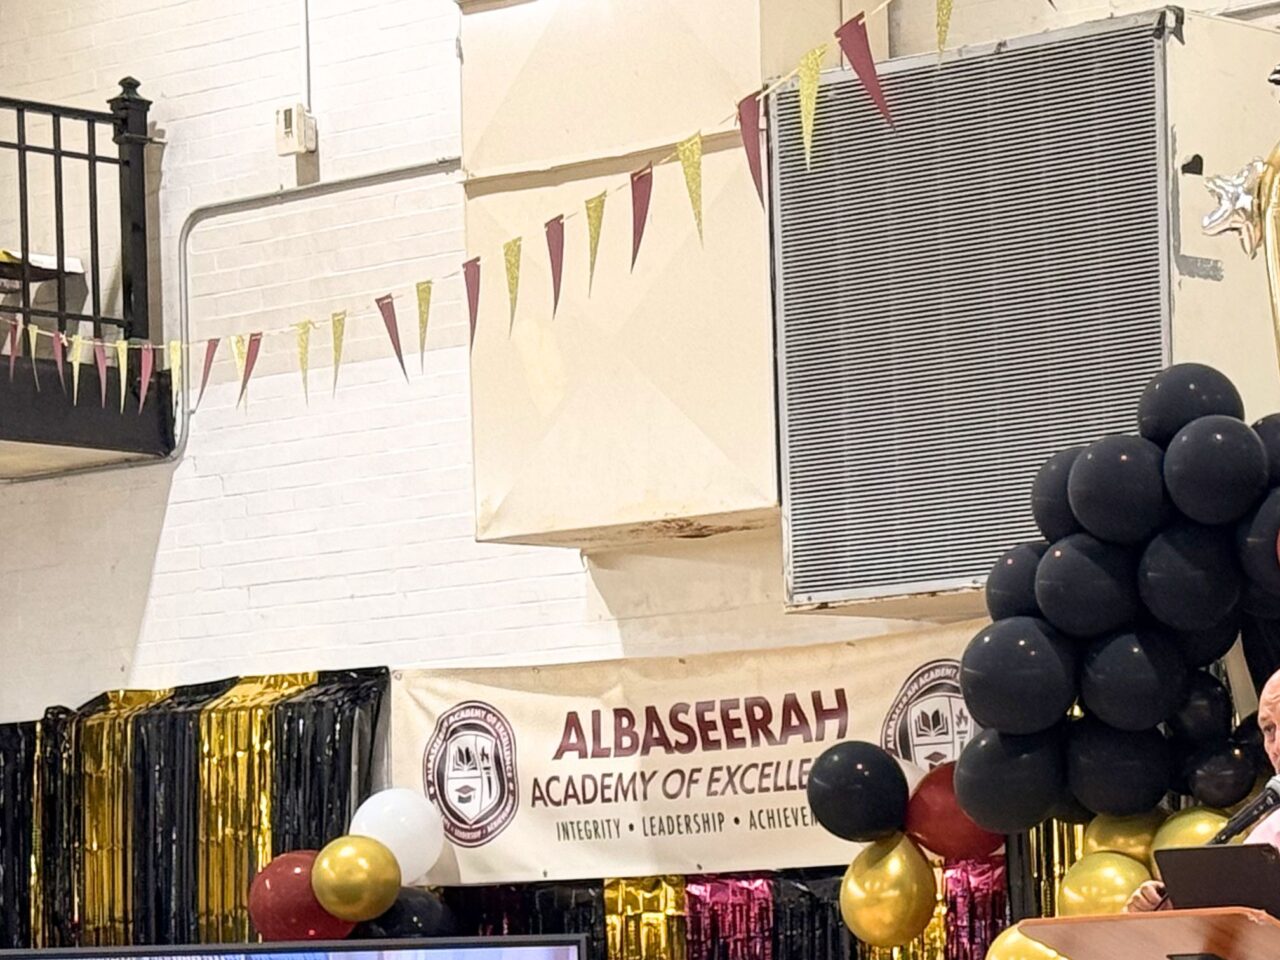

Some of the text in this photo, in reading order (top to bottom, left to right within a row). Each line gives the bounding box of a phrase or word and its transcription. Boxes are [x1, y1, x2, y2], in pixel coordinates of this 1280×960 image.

[552, 688, 849, 760] ALBASEERAH
[531, 758, 811, 808] ACADEMY OF EXCELLE
[556, 806, 818, 842] INTEGRITY LEADERSHIP ACHIEVE
